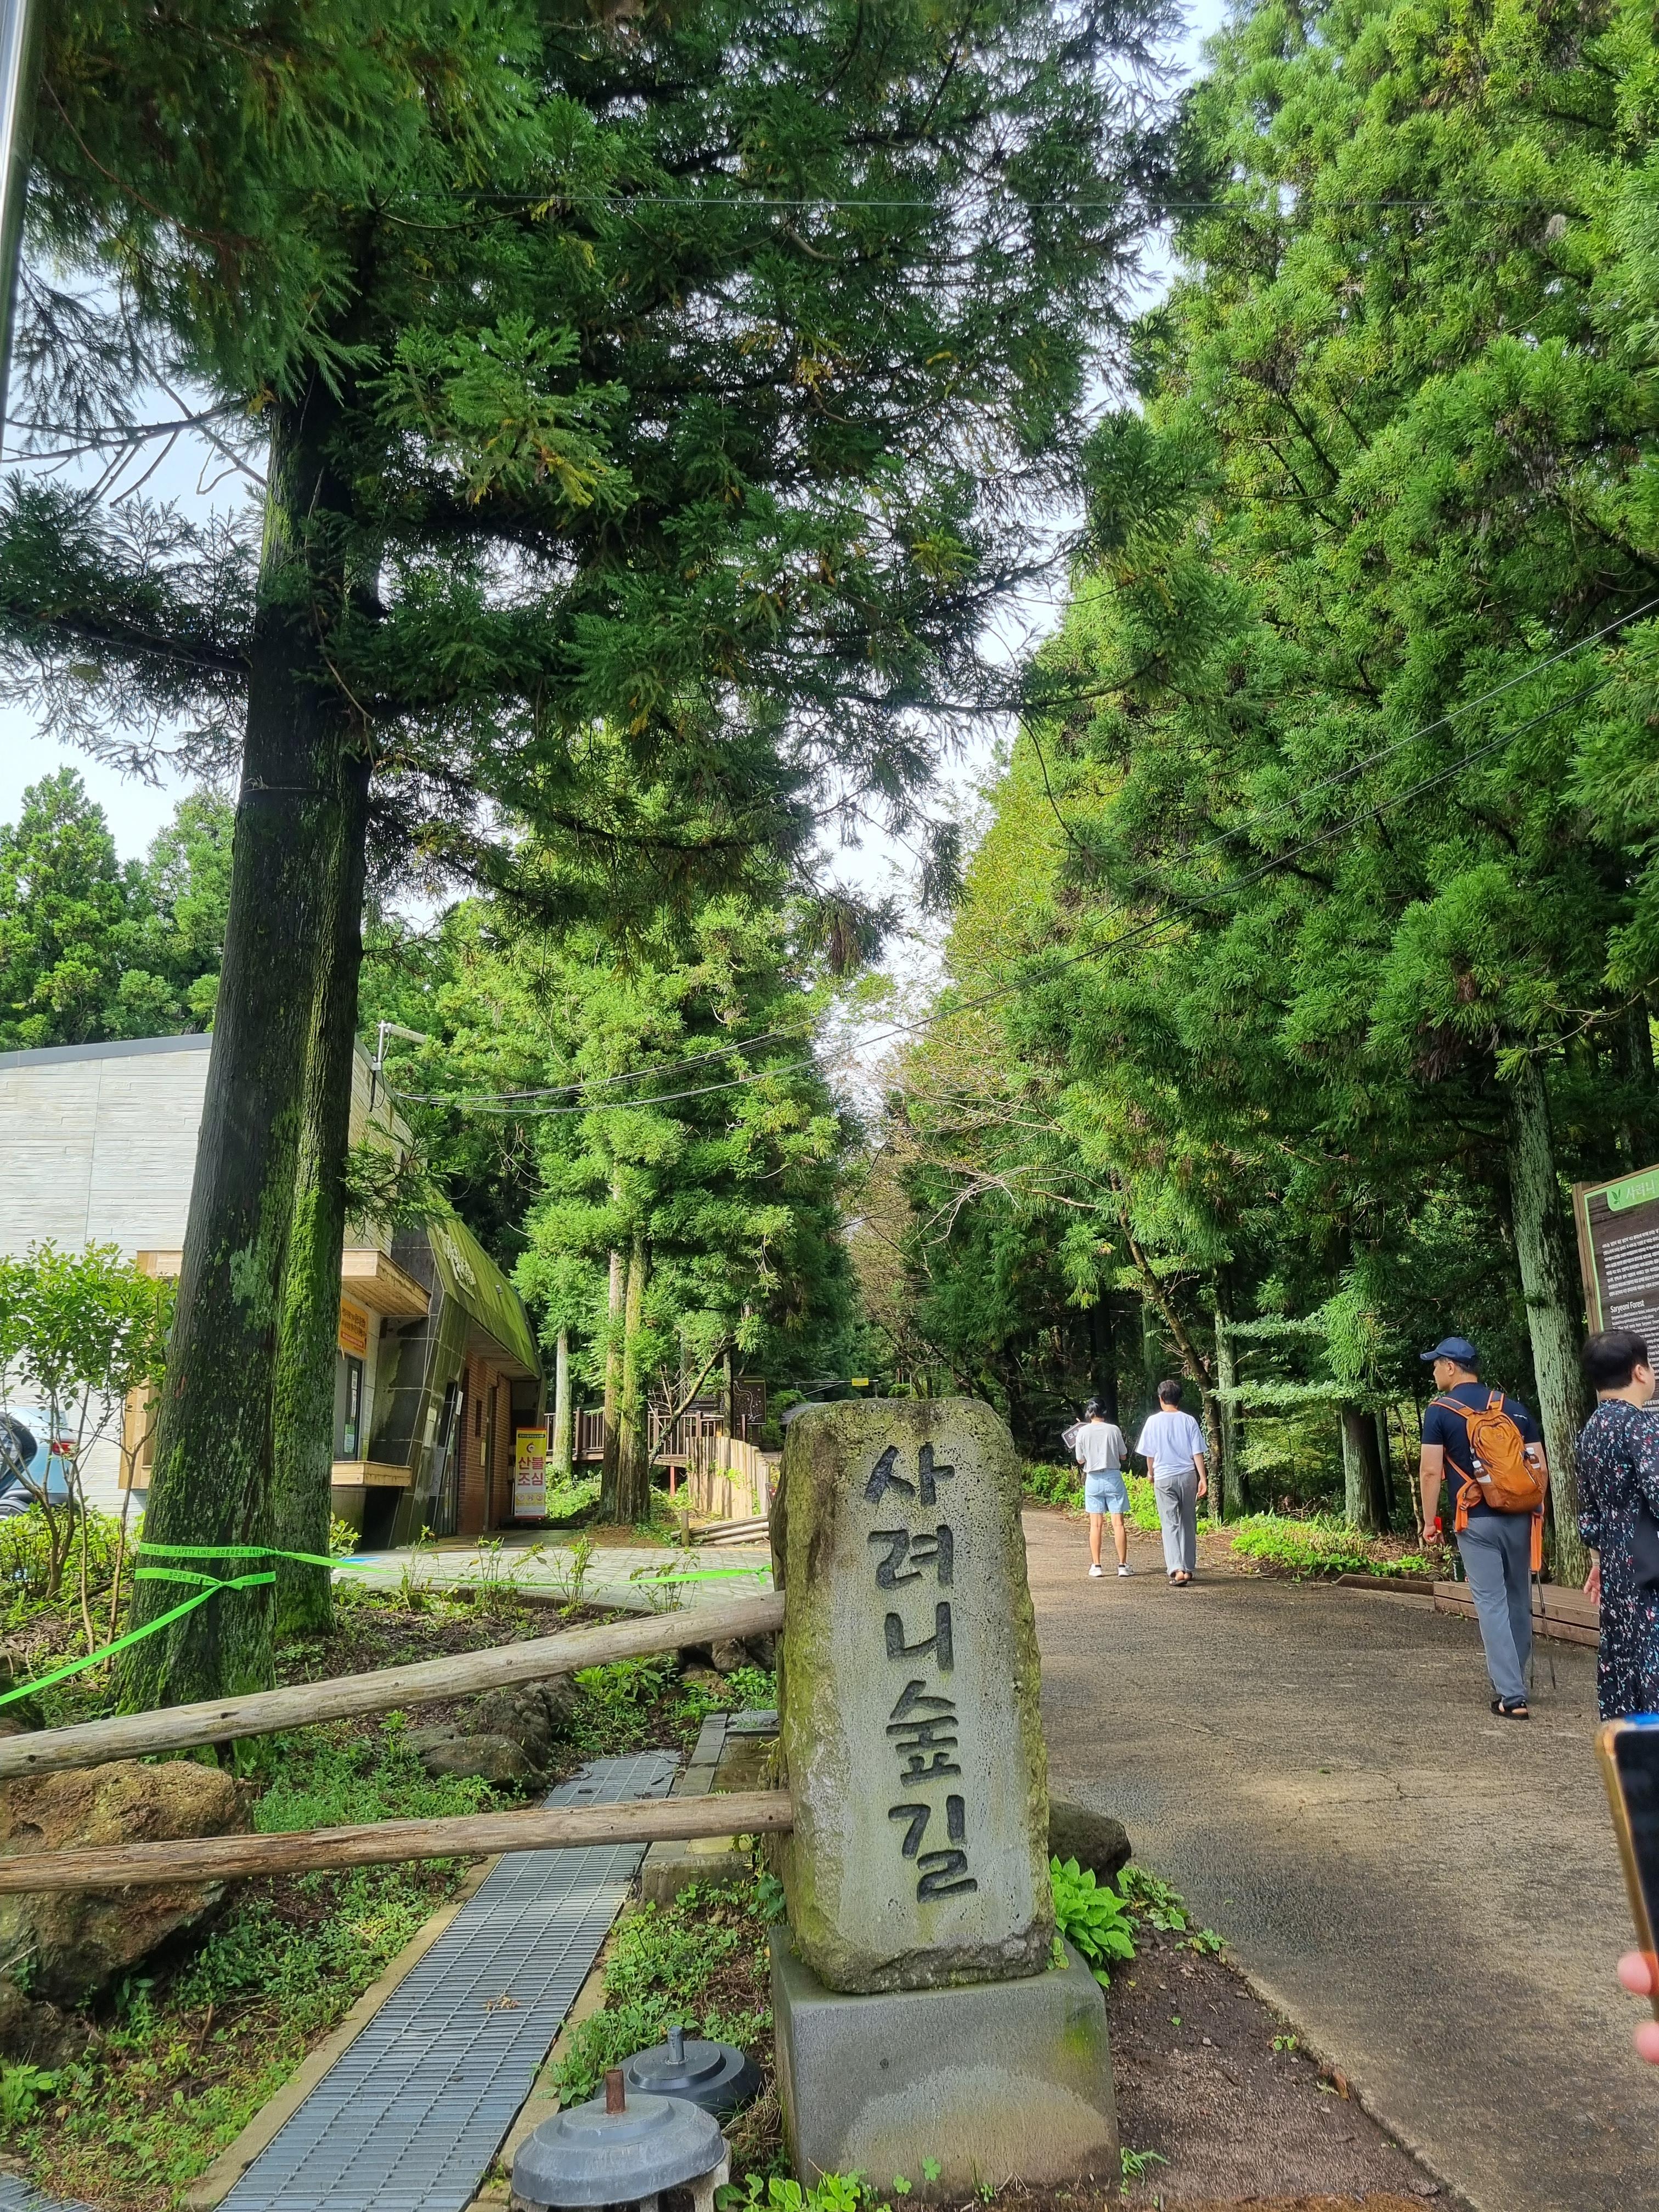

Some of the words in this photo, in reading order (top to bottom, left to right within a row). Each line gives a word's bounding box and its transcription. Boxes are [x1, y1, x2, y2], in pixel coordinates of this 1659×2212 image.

[1626, 1179, 1656, 1200] 사려니
[1610, 1302, 1630, 1314] Saryeoni
[1630, 1299, 1645, 1309] Forest
[518, 1457, 544, 1470] 산불
[517, 1472, 544, 1486] 조심
[865, 1441, 978, 1904] 사려니숲길
